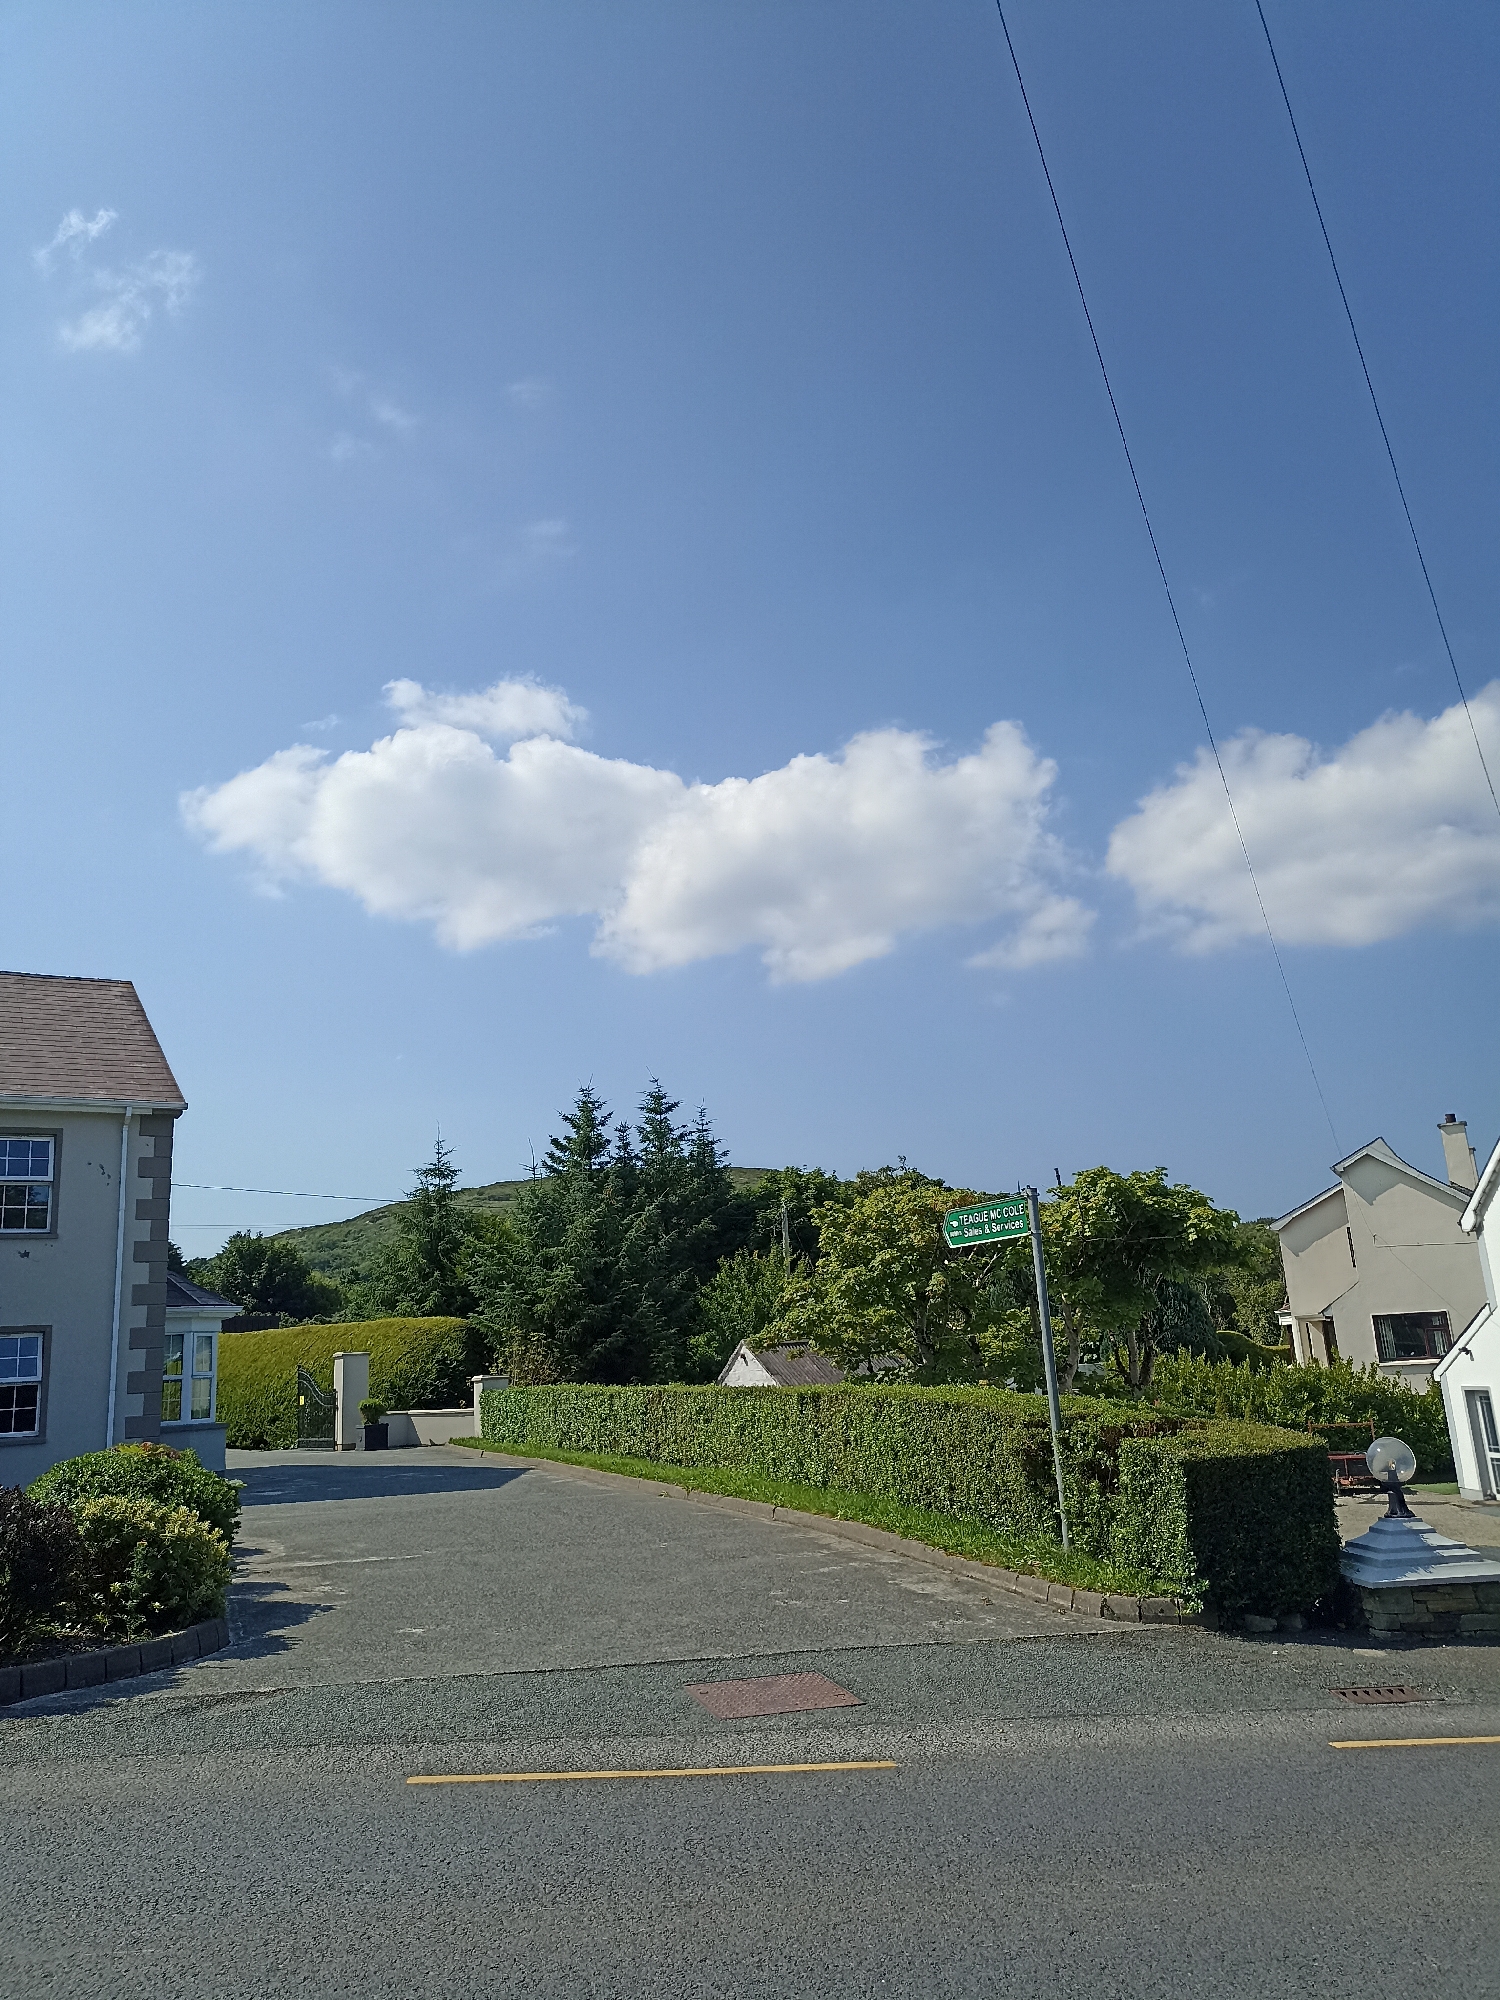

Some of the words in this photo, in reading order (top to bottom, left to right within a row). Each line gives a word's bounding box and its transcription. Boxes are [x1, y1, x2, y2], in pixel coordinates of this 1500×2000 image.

[959, 1211, 989, 1226] TEAGUE
[989, 1209, 1002, 1220] MC
[1002, 1204, 1025, 1218] COLE
[963, 1227, 983, 1238] Sales
[984, 1224, 991, 1234] &
[991, 1220, 1024, 1233] Services
